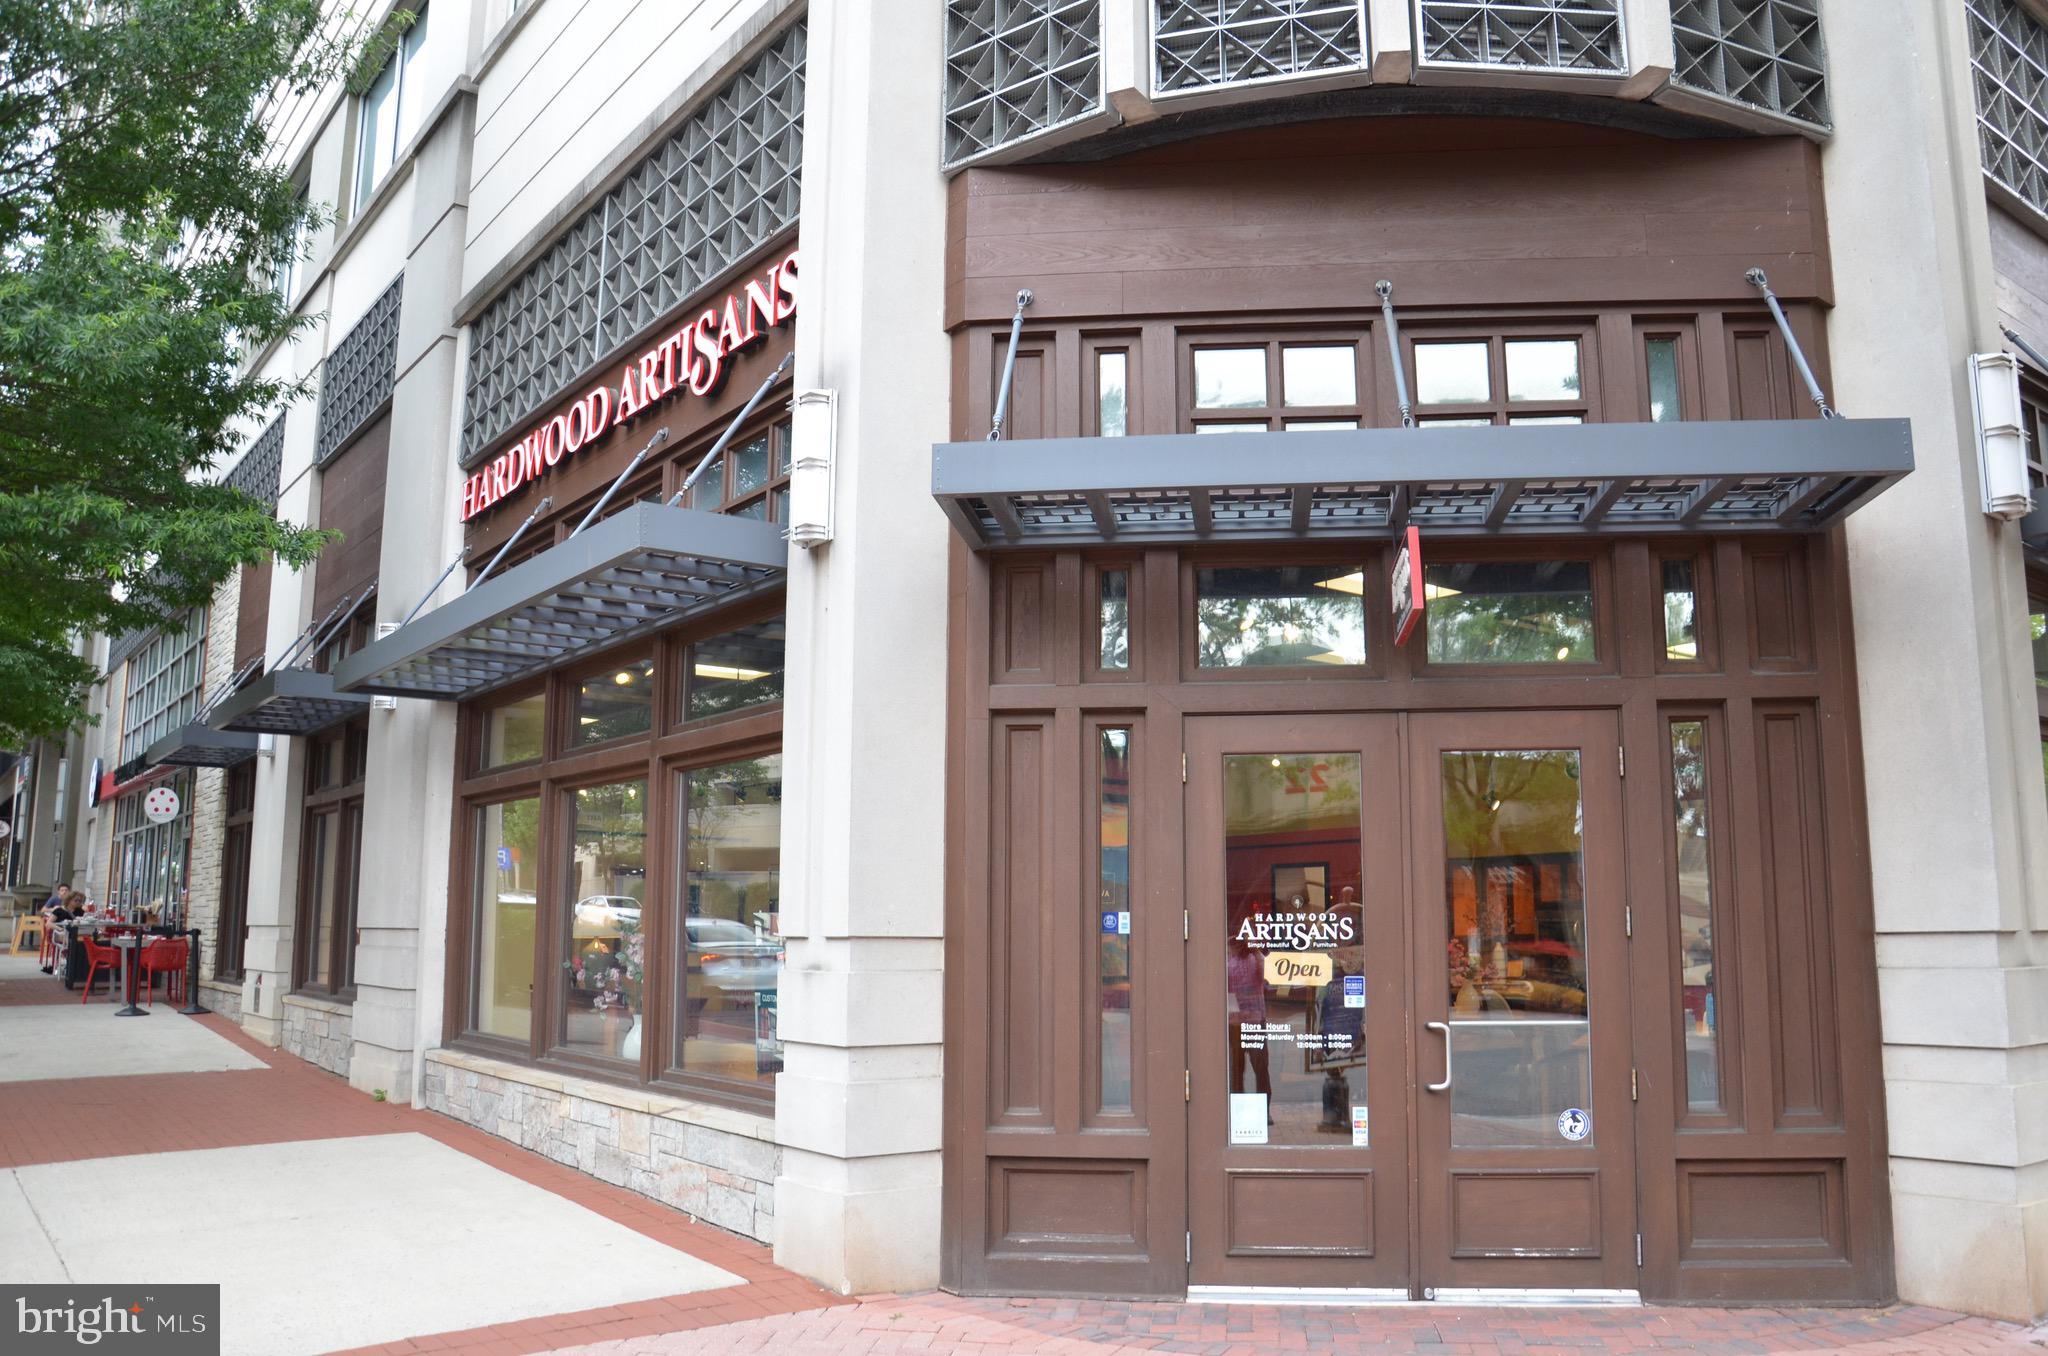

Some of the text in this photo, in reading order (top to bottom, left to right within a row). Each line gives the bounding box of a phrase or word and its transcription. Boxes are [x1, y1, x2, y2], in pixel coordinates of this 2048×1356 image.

[460, 250, 800, 523] HARDWOOD ARTISANS
[1254, 913, 1338, 922] HARDWOOD
[1236, 917, 1354, 951] ARTISANS
[1274, 957, 1322, 982] Open
[1241, 1022, 1262, 1031] Store
[1240, 1042, 1265, 1050] Sunday
